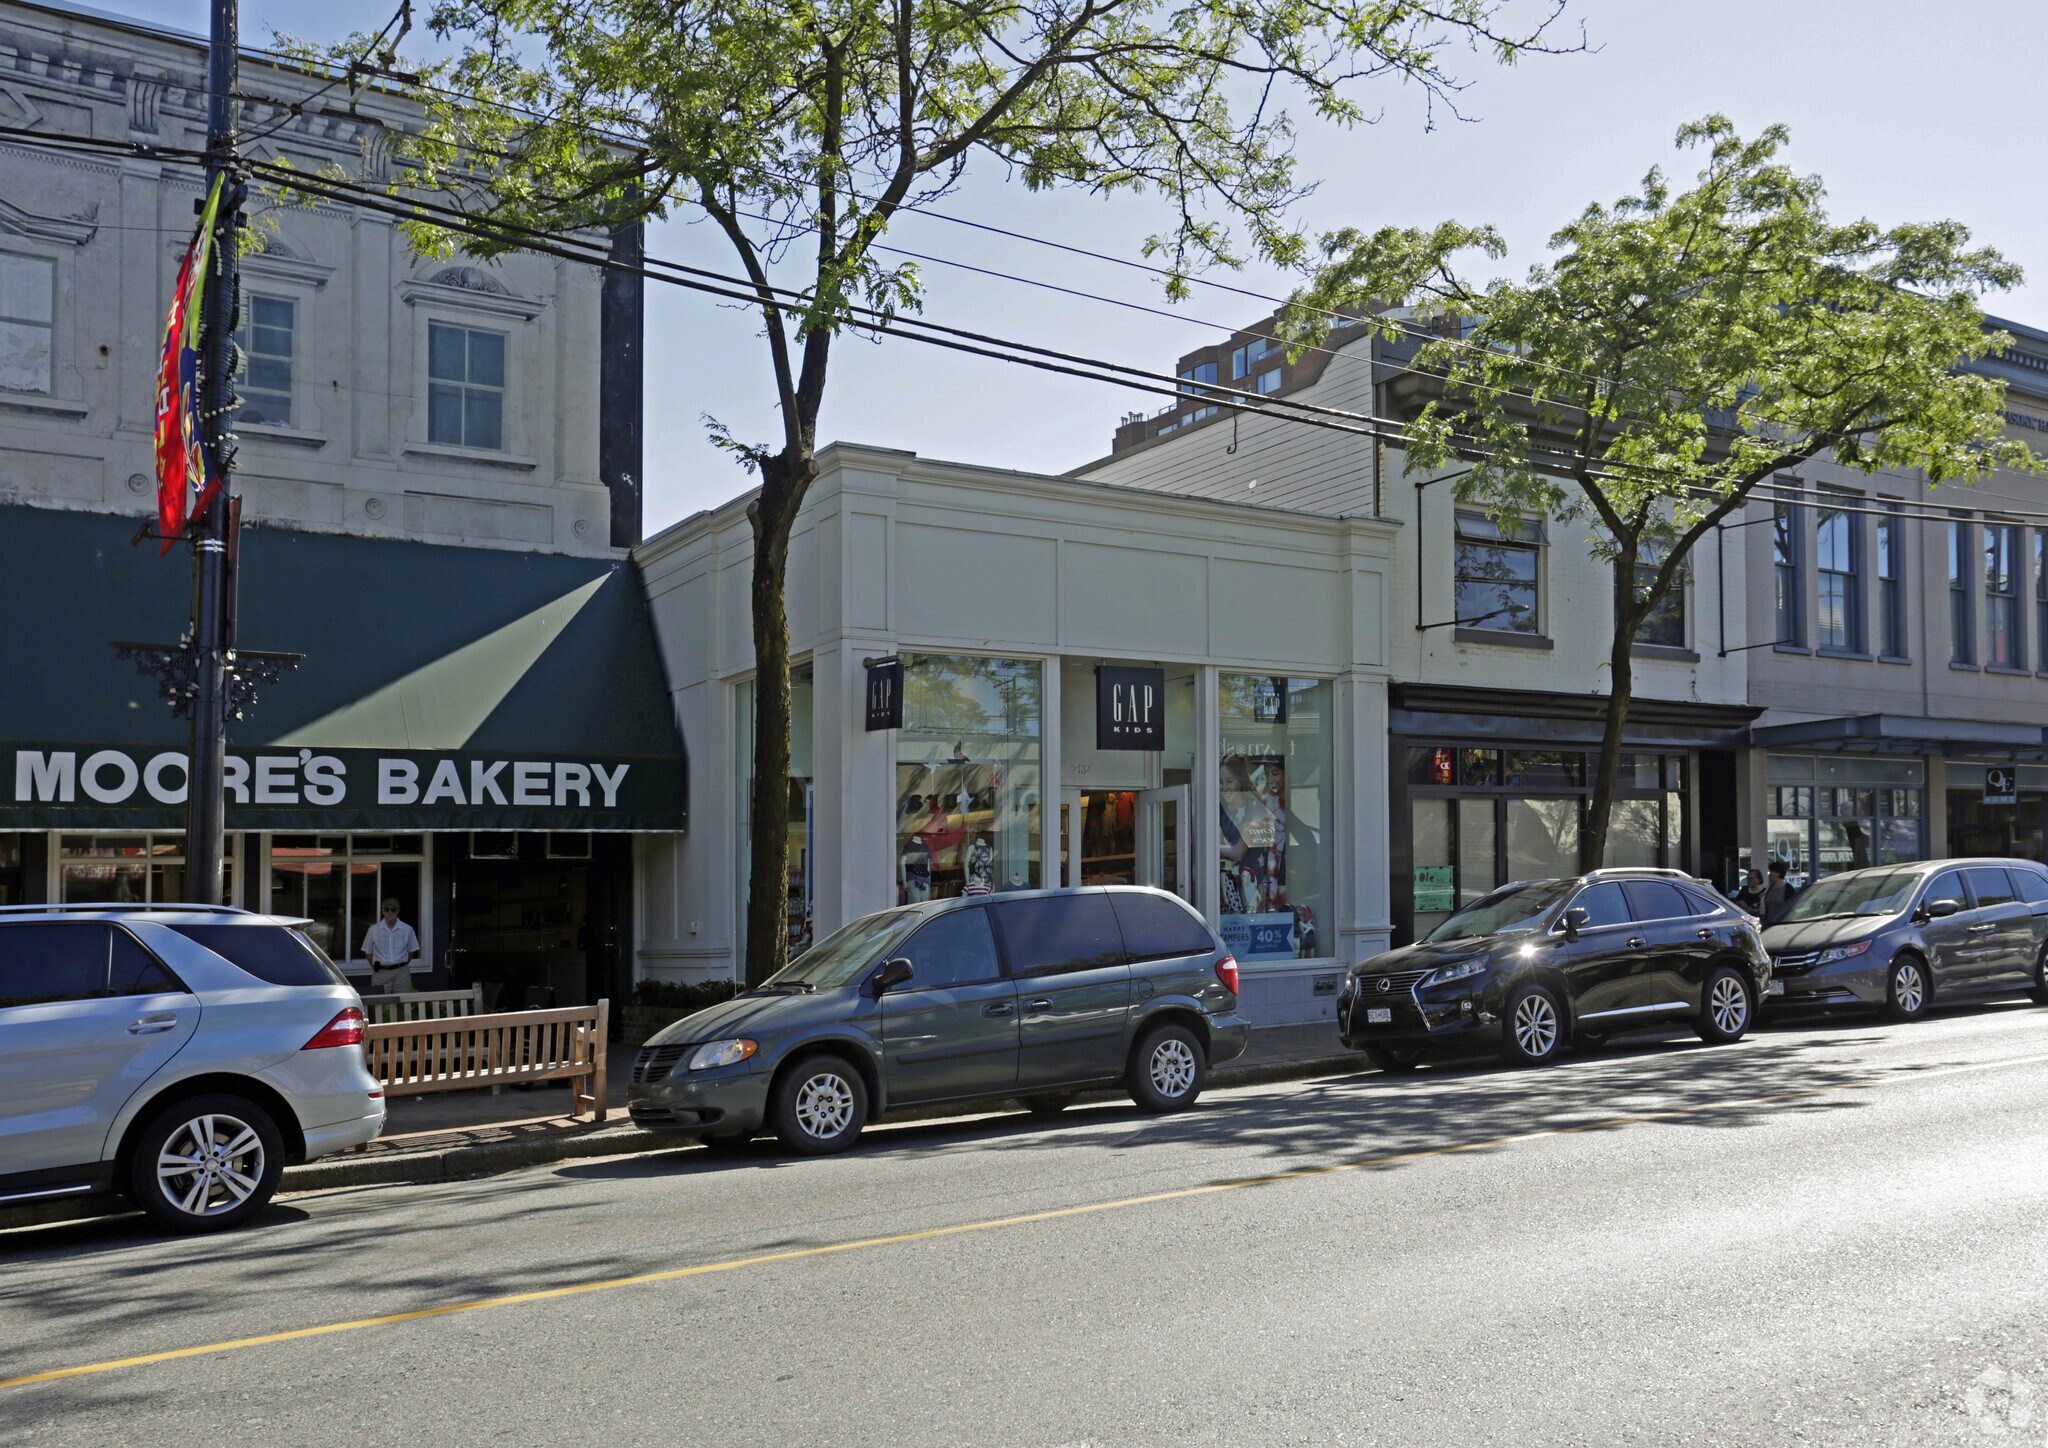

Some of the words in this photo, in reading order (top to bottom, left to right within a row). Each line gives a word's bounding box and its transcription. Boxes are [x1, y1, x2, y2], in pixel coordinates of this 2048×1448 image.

[872, 678, 892, 710] GAP
[1113, 683, 1153, 723] GAP
[1113, 726, 1153, 734] KIDS
[15, 748, 346, 806] MOORE'S
[377, 758, 631, 807] BAKERY
[1987, 769, 2014, 793] QE
[1777, 837, 1800, 870] QE
[1256, 929, 1282, 943] 40%
